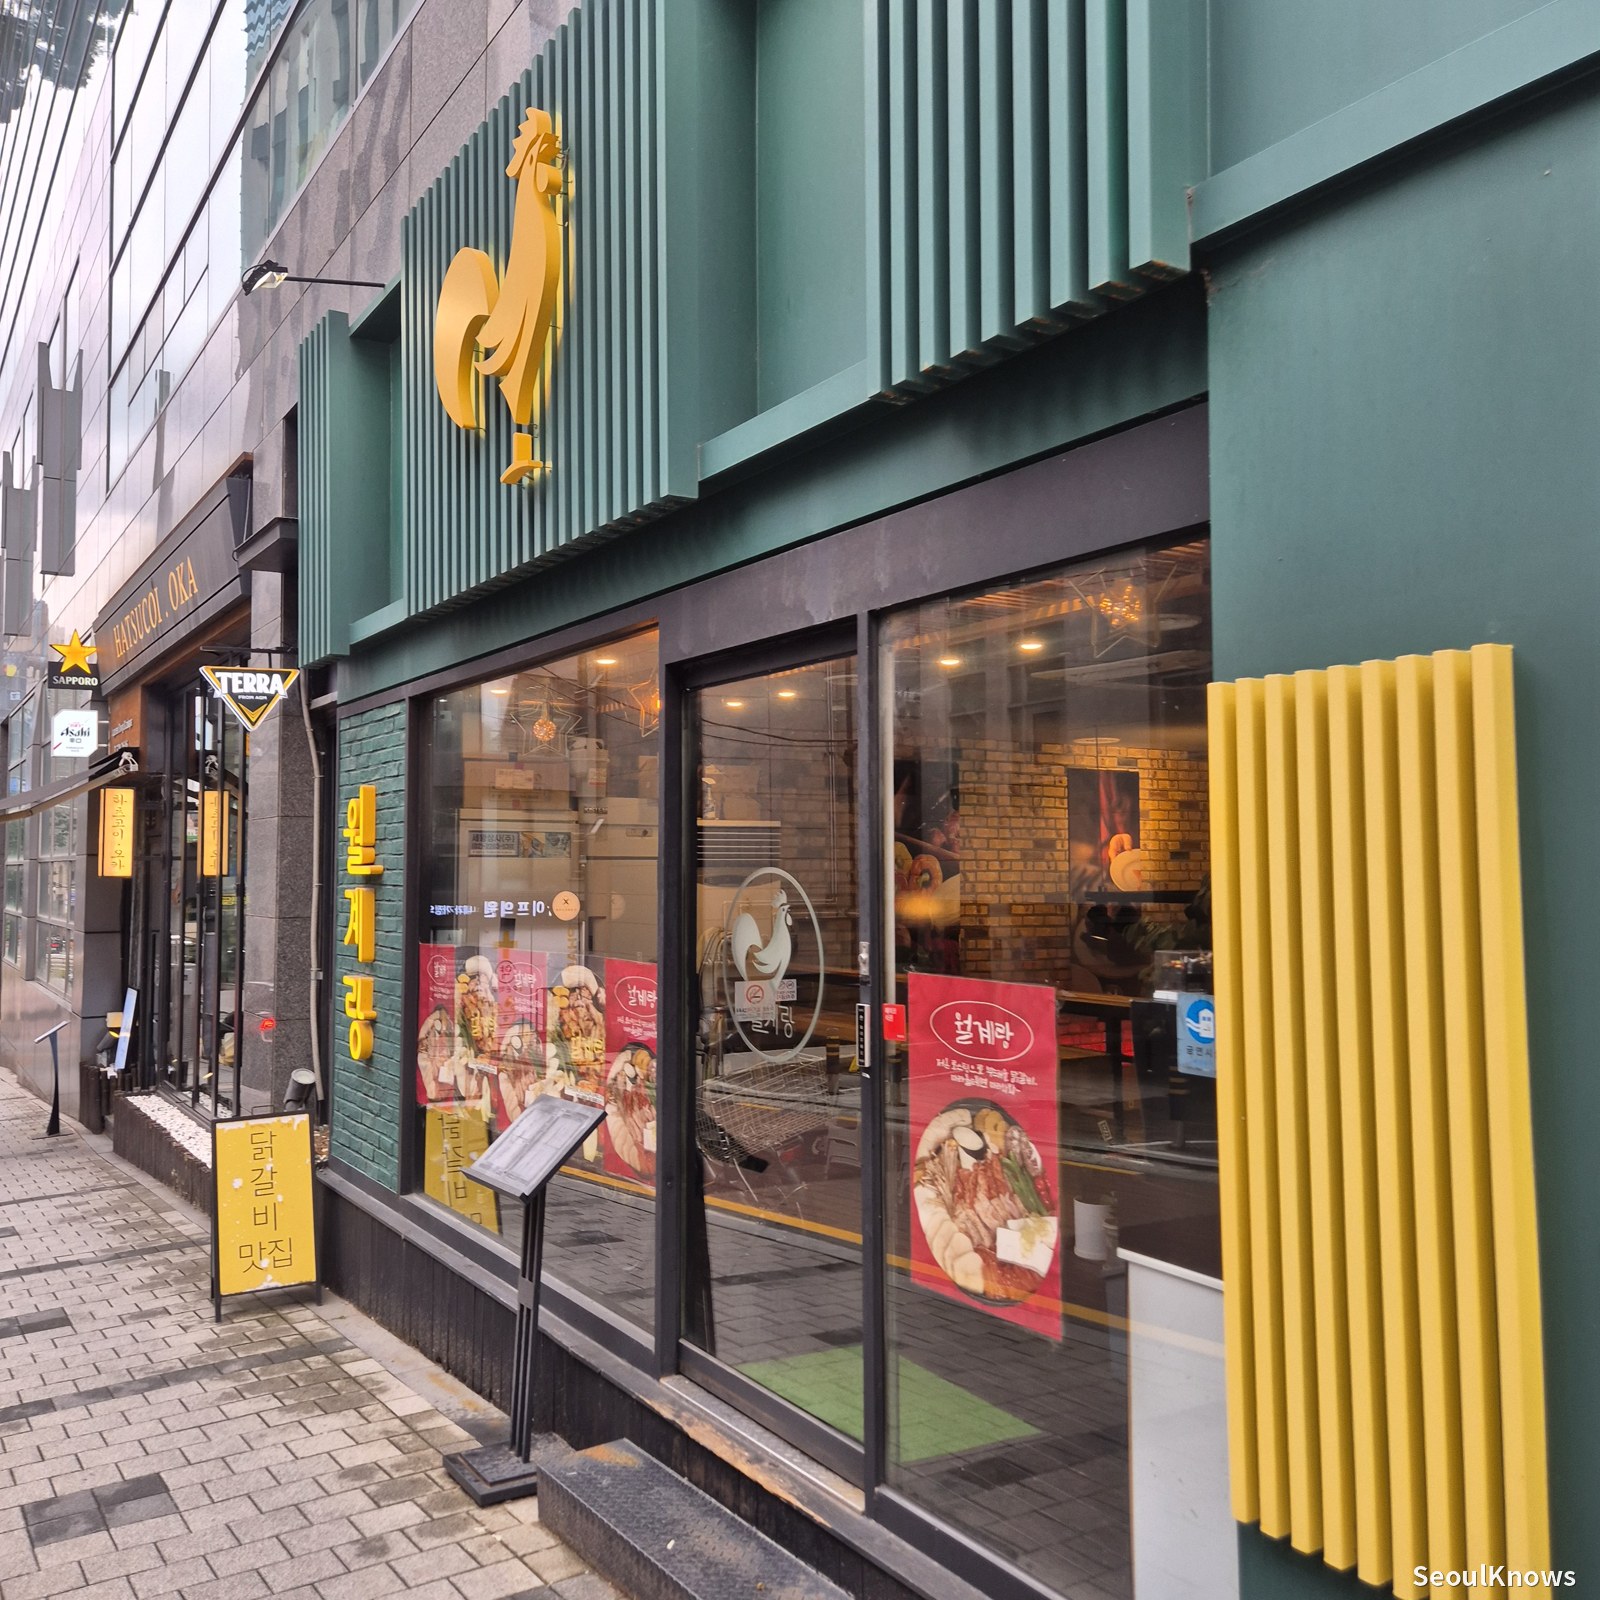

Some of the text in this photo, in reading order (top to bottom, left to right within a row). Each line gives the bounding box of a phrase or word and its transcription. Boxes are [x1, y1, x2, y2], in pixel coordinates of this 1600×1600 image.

[168, 555, 199, 611] OKA
[53, 675, 98, 686] SAPPORO
[214, 671, 286, 698] TERRA
[60, 726, 91, 737] Asahi
[954, 1011, 1014, 1049] 월계랑
[250, 1130, 277, 1231] 닭갈비
[239, 1237, 293, 1273] 맛집
